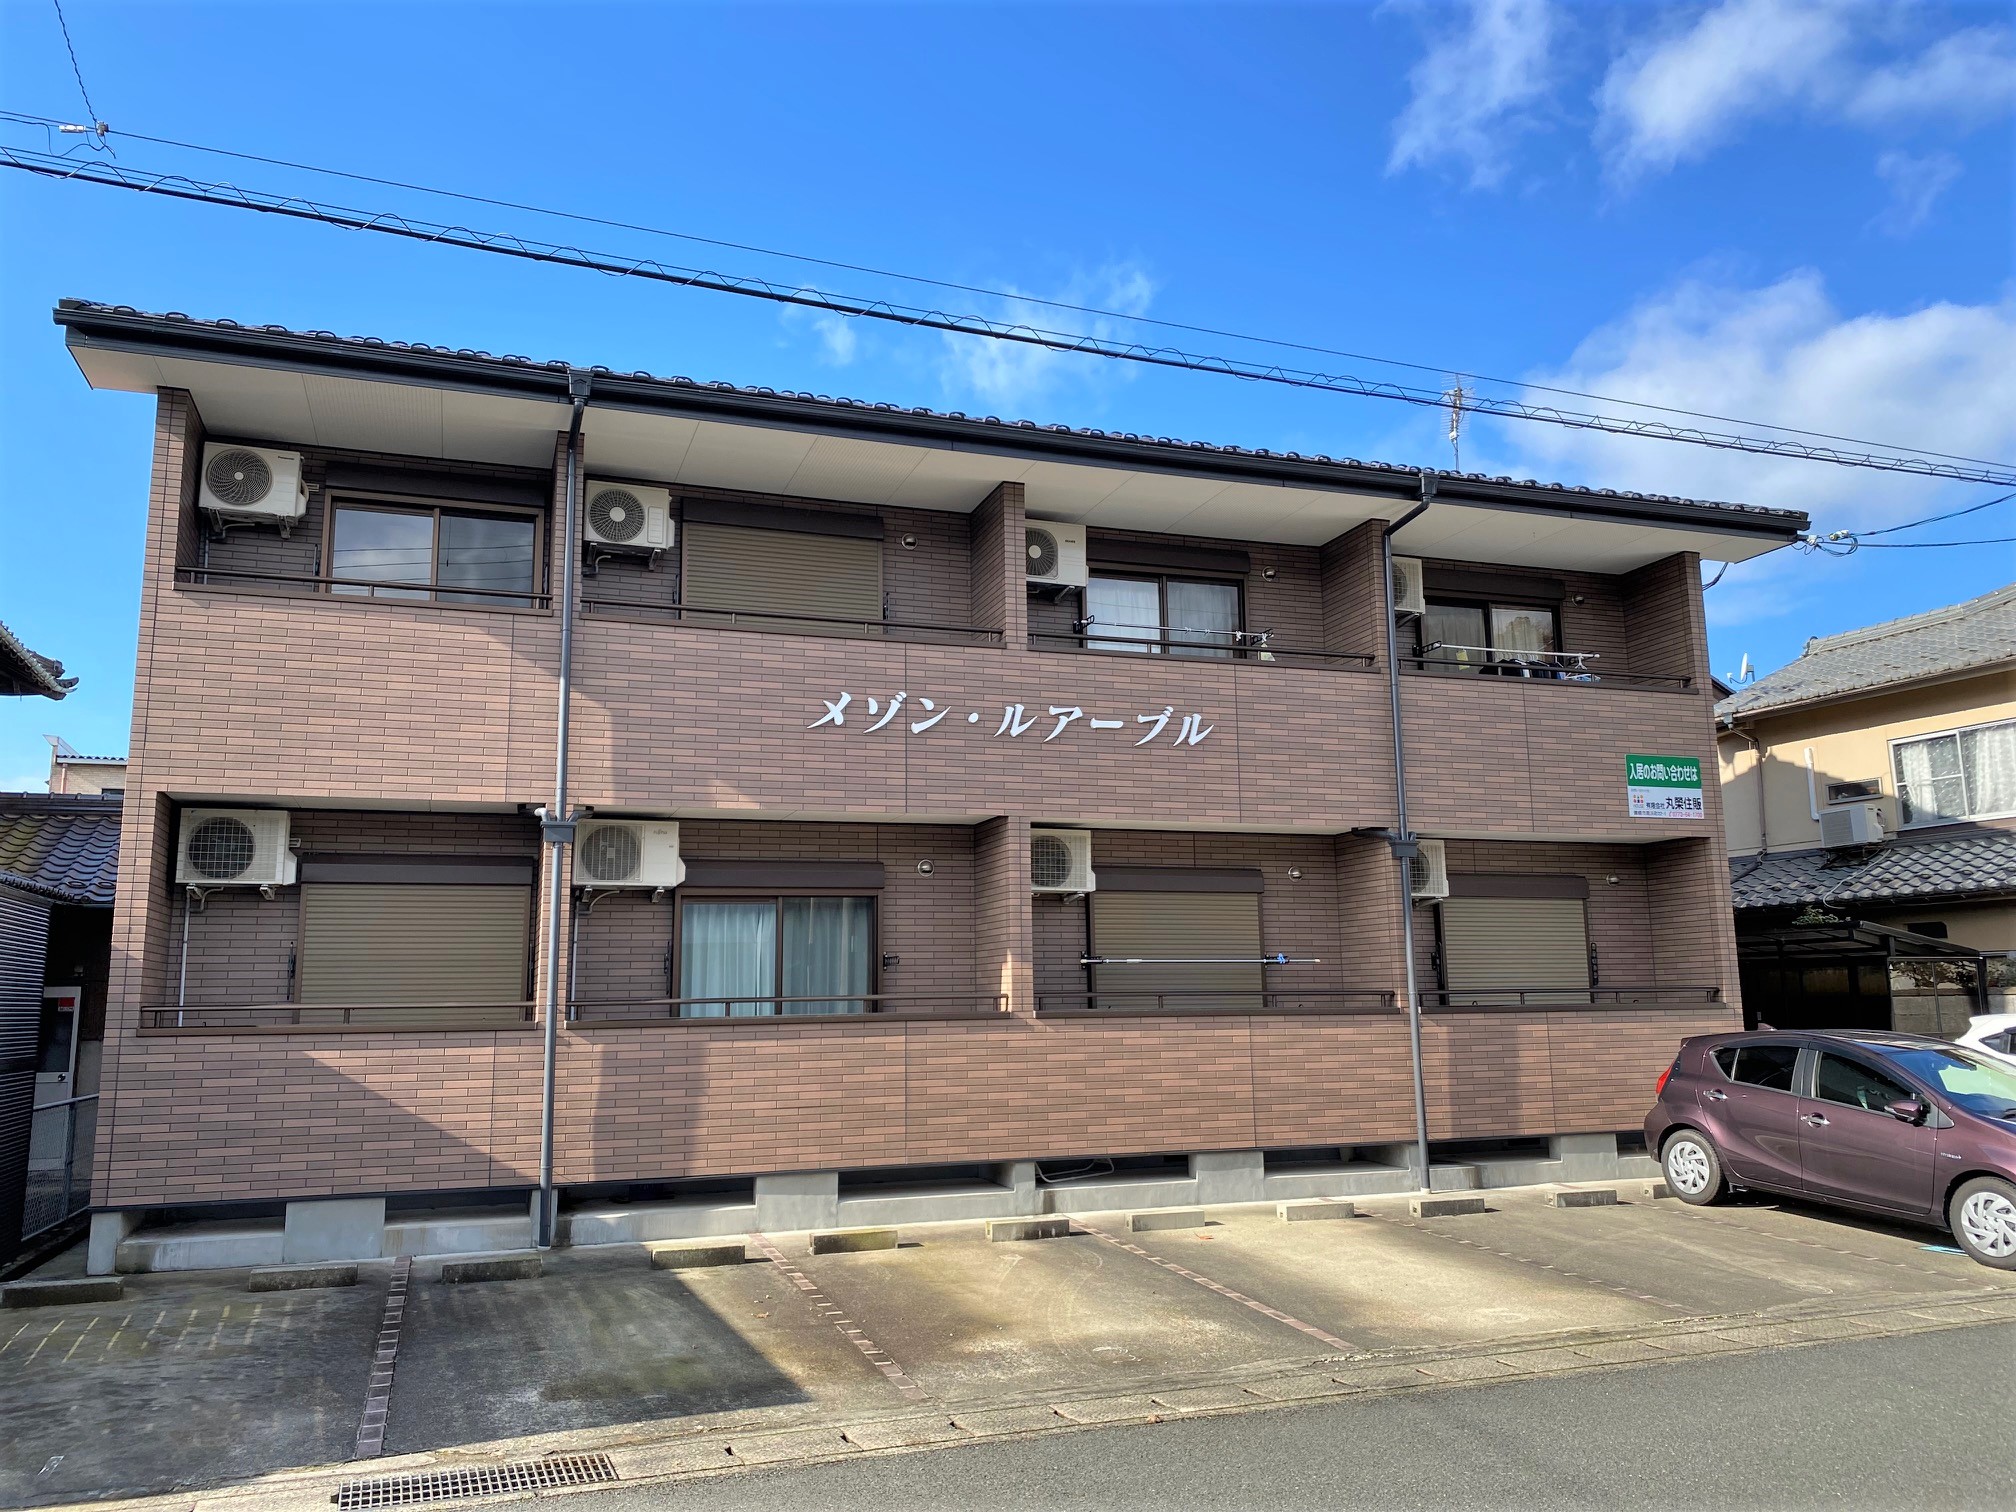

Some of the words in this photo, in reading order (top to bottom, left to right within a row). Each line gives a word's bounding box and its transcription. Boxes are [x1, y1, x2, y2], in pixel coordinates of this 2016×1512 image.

[807, 691, 1215, 747] メゾン・ルアーブル
[1629, 763, 1698, 781] 入居のお問い合わせは
